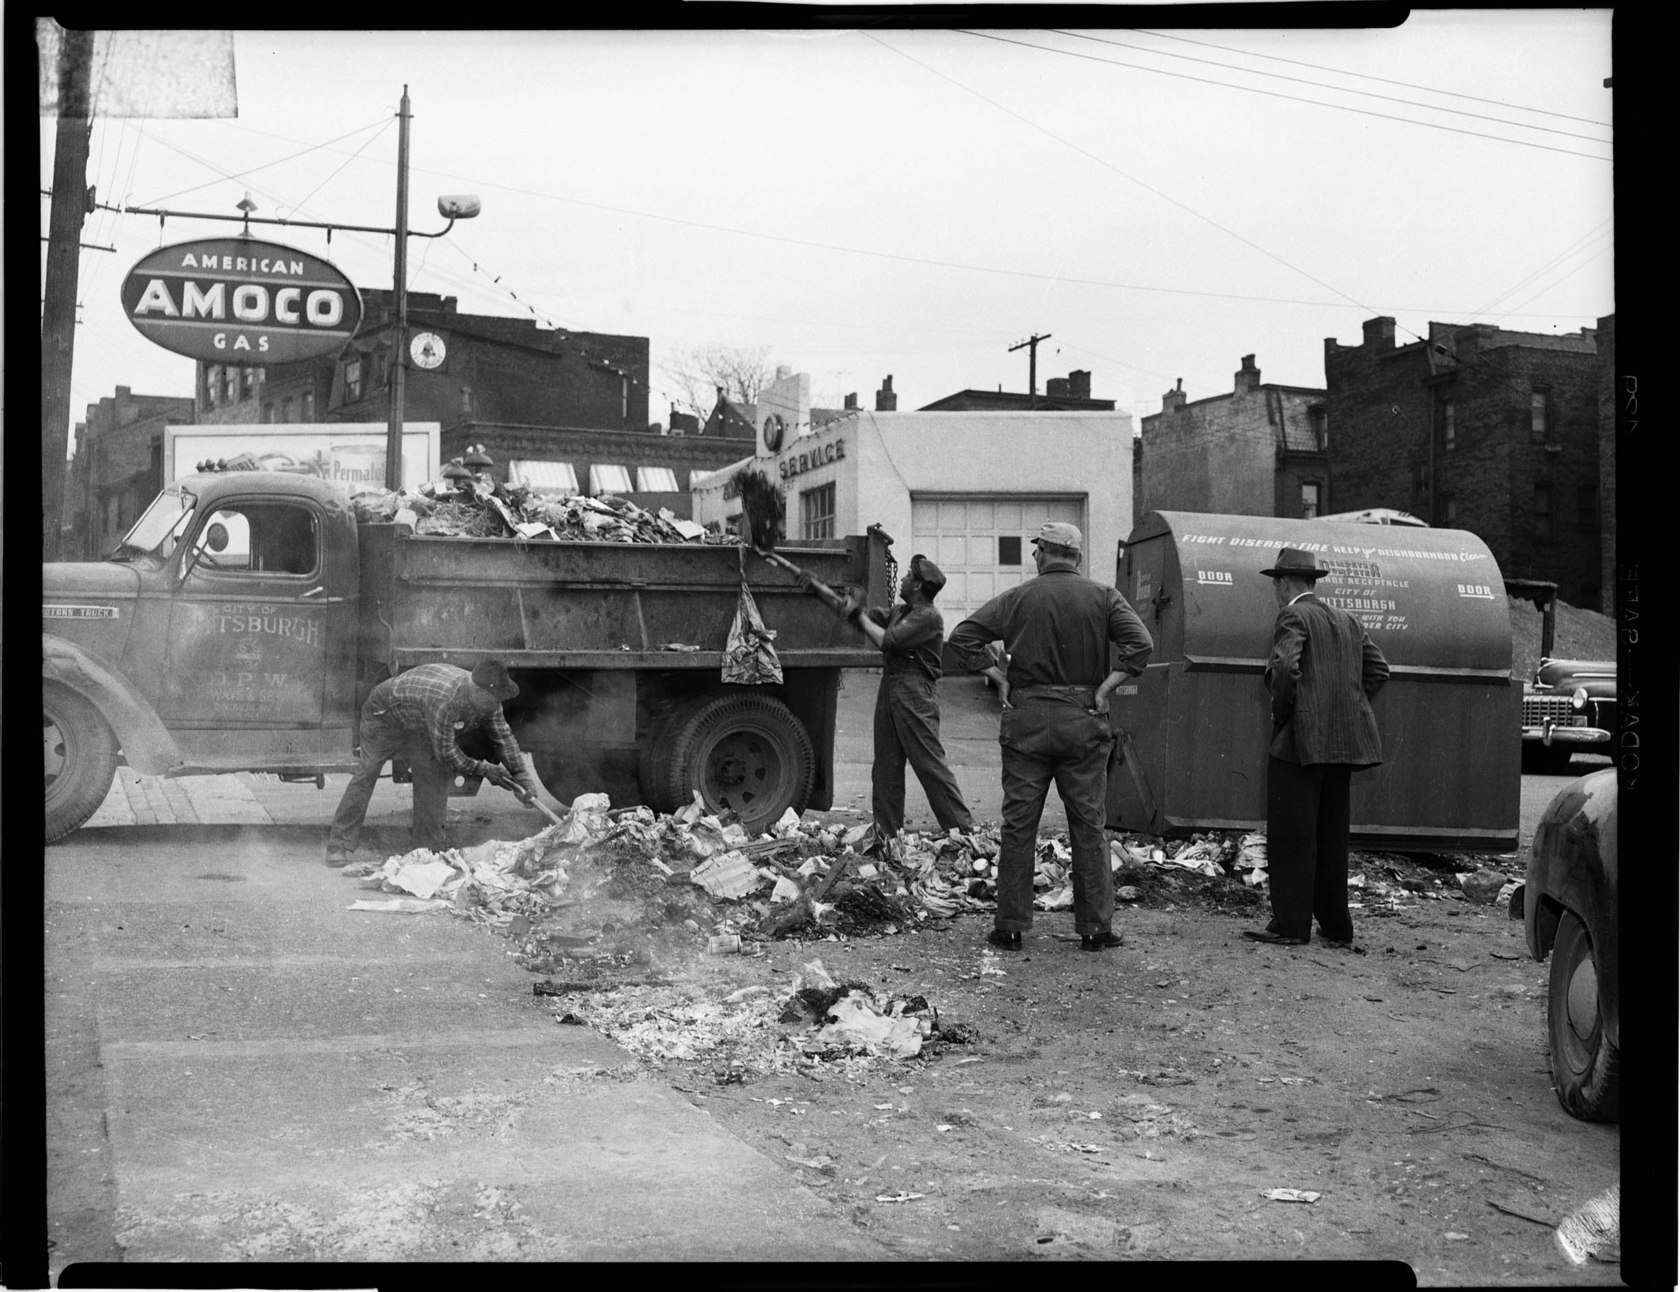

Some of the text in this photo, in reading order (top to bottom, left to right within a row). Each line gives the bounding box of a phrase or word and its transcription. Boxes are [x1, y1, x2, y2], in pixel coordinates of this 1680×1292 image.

[181, 253, 304, 275] AMERICAN
[133, 278, 344, 327] AMOCO
[213, 333, 269, 352] GAS
[778, 438, 846, 480] SERVICE
[1182, 534, 1226, 545] FIGHT
[1229, 537, 1292, 549] DISEASE
[1298, 542, 1330, 553] FIRE
[1198, 570, 1233, 582] DOOR
[1348, 577, 1409, 589] RECEPTACLE
[1334, 588, 1360, 596] CITY
[1457, 584, 1491, 595] DOOR
[44, 608, 109, 618] OTORS TRUCK
[222, 604, 277, 615] CITY OF
[1387, 615, 1406, 623] YOU
[219, 615, 319, 648] TSBURGH
[1386, 623, 1409, 631] CITY
